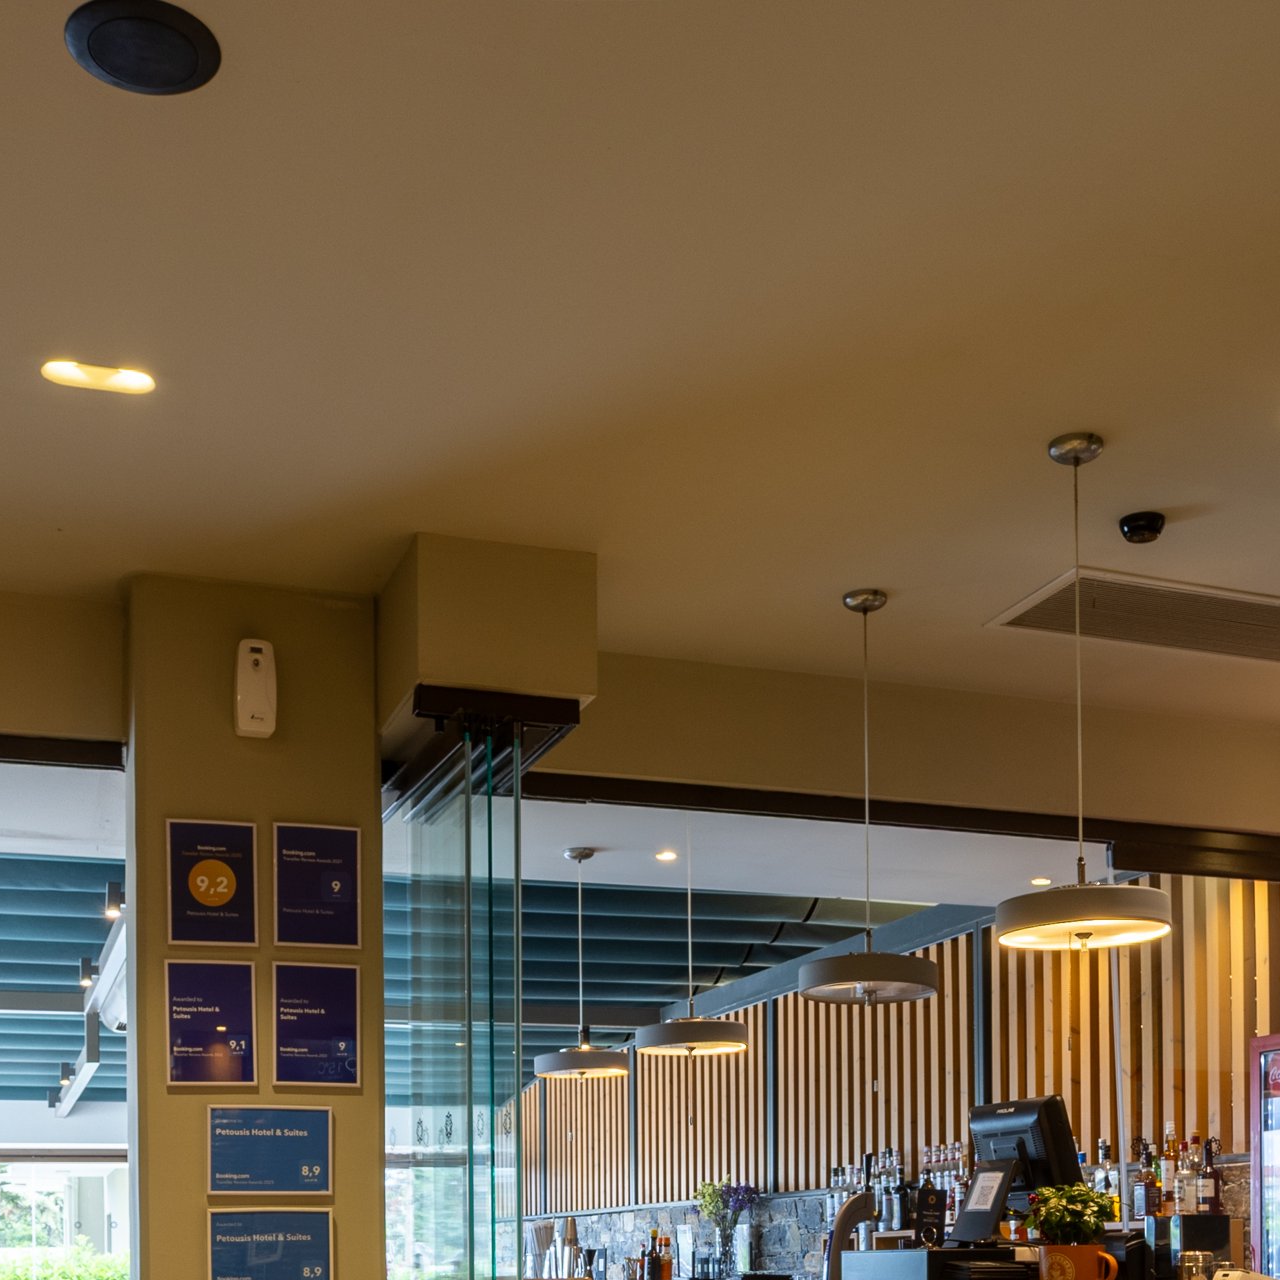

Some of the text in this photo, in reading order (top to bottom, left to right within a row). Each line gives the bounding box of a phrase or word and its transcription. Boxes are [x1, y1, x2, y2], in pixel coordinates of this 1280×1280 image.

[282, 849, 316, 857] Booking.com
[196, 876, 228, 894] 9,2
[331, 880, 341, 893] 9
[229, 1040, 246, 1051] 9,1
[338, 1042, 346, 1051] 9
[216, 1128, 250, 1136] Petousis
[252, 1128, 274, 1136] Hotel
[284, 1129, 308, 1137] Suites
[301, 1166, 321, 1177] 8,9
[216, 1234, 251, 1243] Petousis
[277, 1233, 284, 1241] &
[286, 1233, 311, 1241] Suites
[303, 1267, 322, 1278] 8,9
